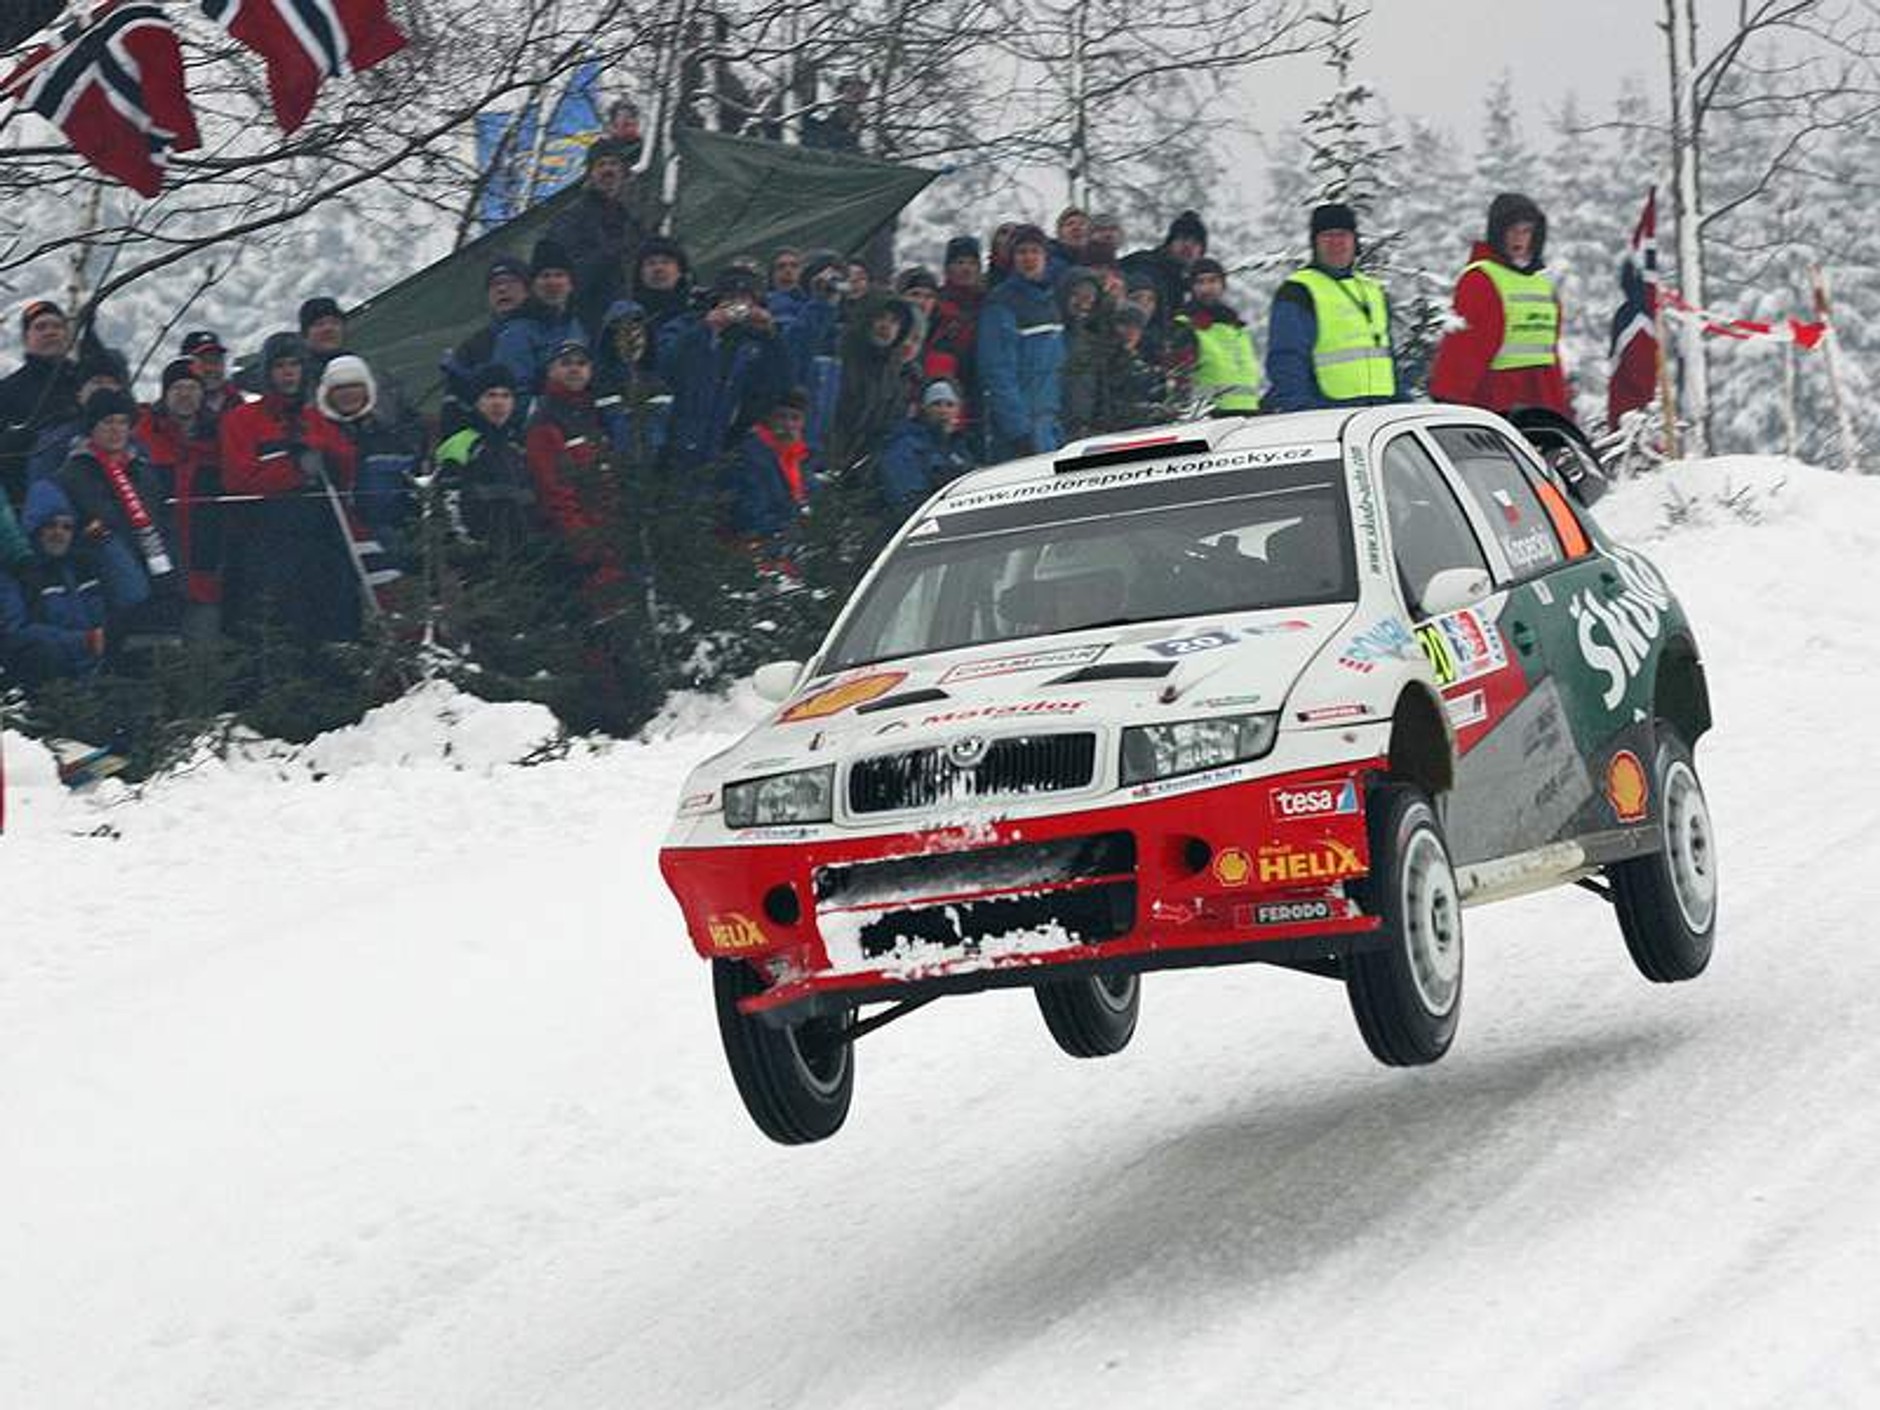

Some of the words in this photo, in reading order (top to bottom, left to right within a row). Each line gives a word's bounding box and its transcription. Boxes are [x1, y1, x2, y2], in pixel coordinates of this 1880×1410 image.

[948, 447, 1314, 510] www.motorsport-kopecky.cz
[1167, 635, 1224, 654] 20
[922, 699, 1086, 726] Matador
[1277, 790, 1333, 814] tesa
[1259, 838, 1369, 882] HELIX
[1258, 903, 1328, 923] FERODO
[709, 913, 769, 947] HELIX
